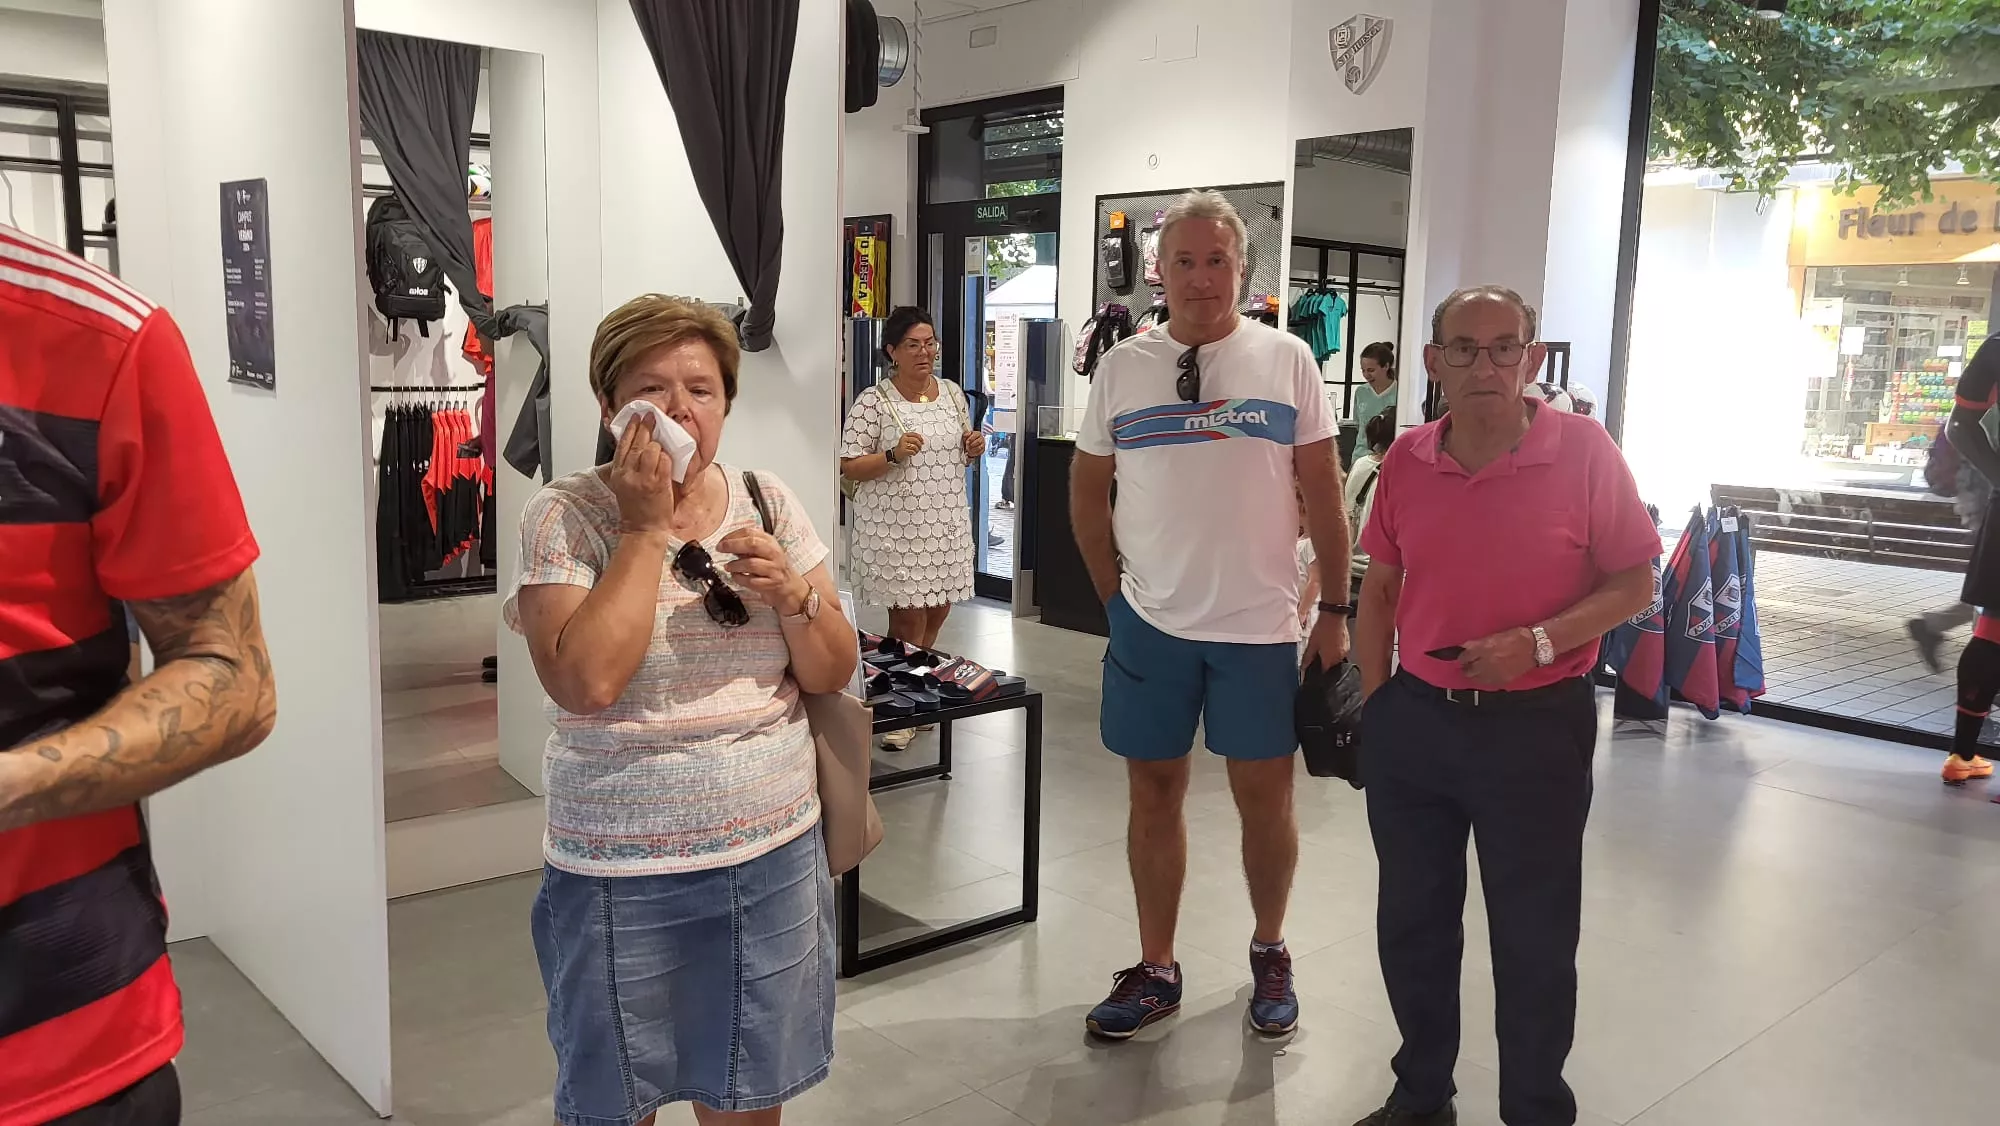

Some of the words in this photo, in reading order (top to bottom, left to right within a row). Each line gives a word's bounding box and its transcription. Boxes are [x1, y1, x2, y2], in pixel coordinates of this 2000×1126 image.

[1351, 24, 1383, 54] HUESCA
[977, 205, 1006, 219] SALIDA
[1838, 206, 1925, 241] Fleur
[1938, 200, 1978, 234] de
[1184, 408, 1269, 430] mistral
